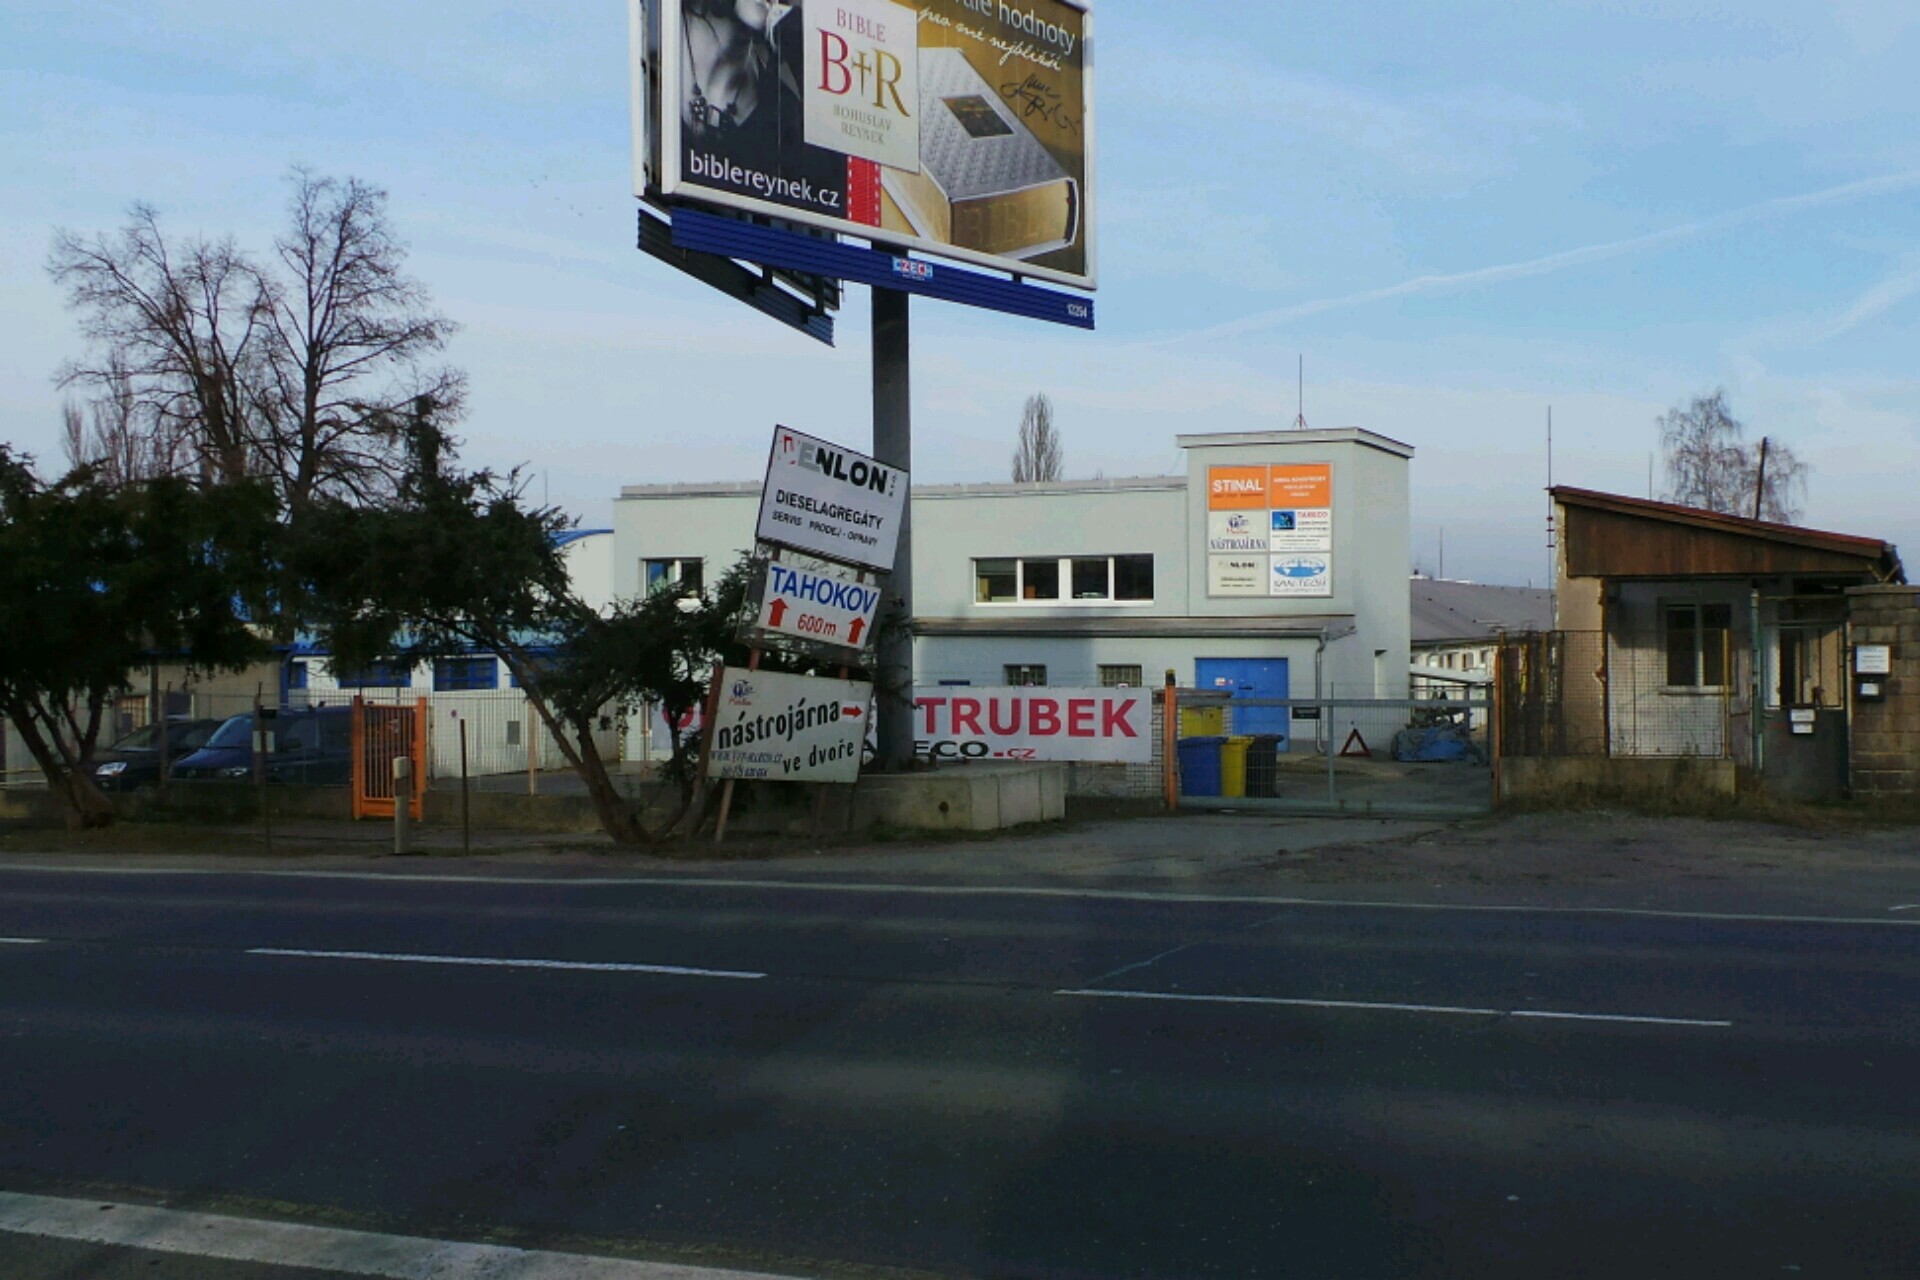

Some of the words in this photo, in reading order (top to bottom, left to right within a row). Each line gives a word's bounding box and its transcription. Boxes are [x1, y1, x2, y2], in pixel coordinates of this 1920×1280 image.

[837, 8, 887, 43] BIBLE
[917, 6, 951, 27] pro
[955, 22, 986, 42] své
[998, 0, 1076, 55] hodnoty
[833, 103, 893, 132] BOHUSLAV
[841, 121, 886, 146] REYNEK
[689, 149, 841, 208] biblereynek.cz
[1213, 479, 1264, 492] STINAL
[772, 510, 802, 526] SERVIS
[776, 489, 884, 530] DIESELAGREGÁTY
[769, 565, 879, 614] TAHOKOV
[718, 697, 840, 750] nástrojárna
[913, 697, 1138, 738] TRUBEK
[783, 755, 801, 774] ve
[808, 739, 855, 768] dvoře
